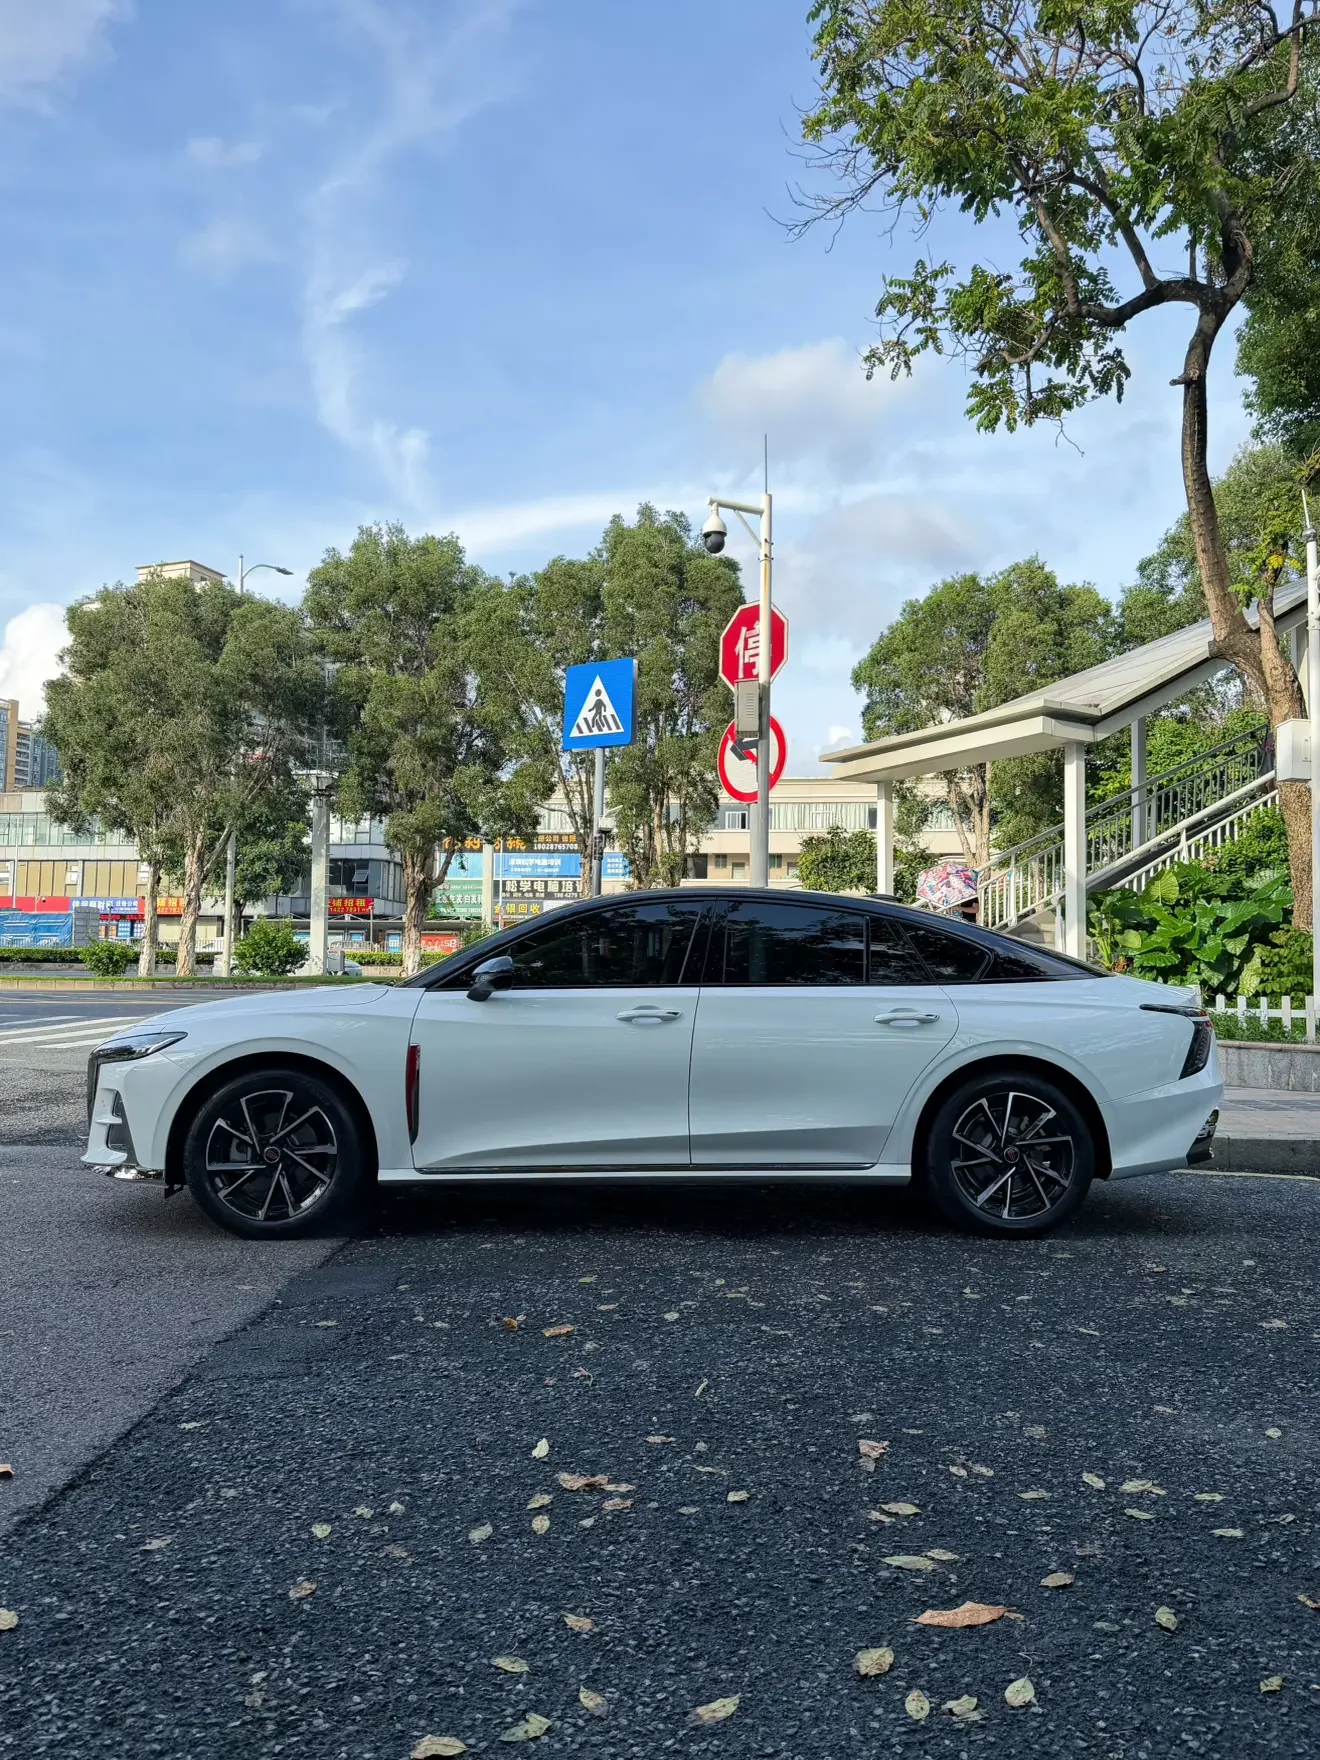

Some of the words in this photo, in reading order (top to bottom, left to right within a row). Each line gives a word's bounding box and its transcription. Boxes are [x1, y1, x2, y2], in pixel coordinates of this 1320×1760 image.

[735, 621, 771, 678] 停
[494, 903, 541, 914] 金银回收
